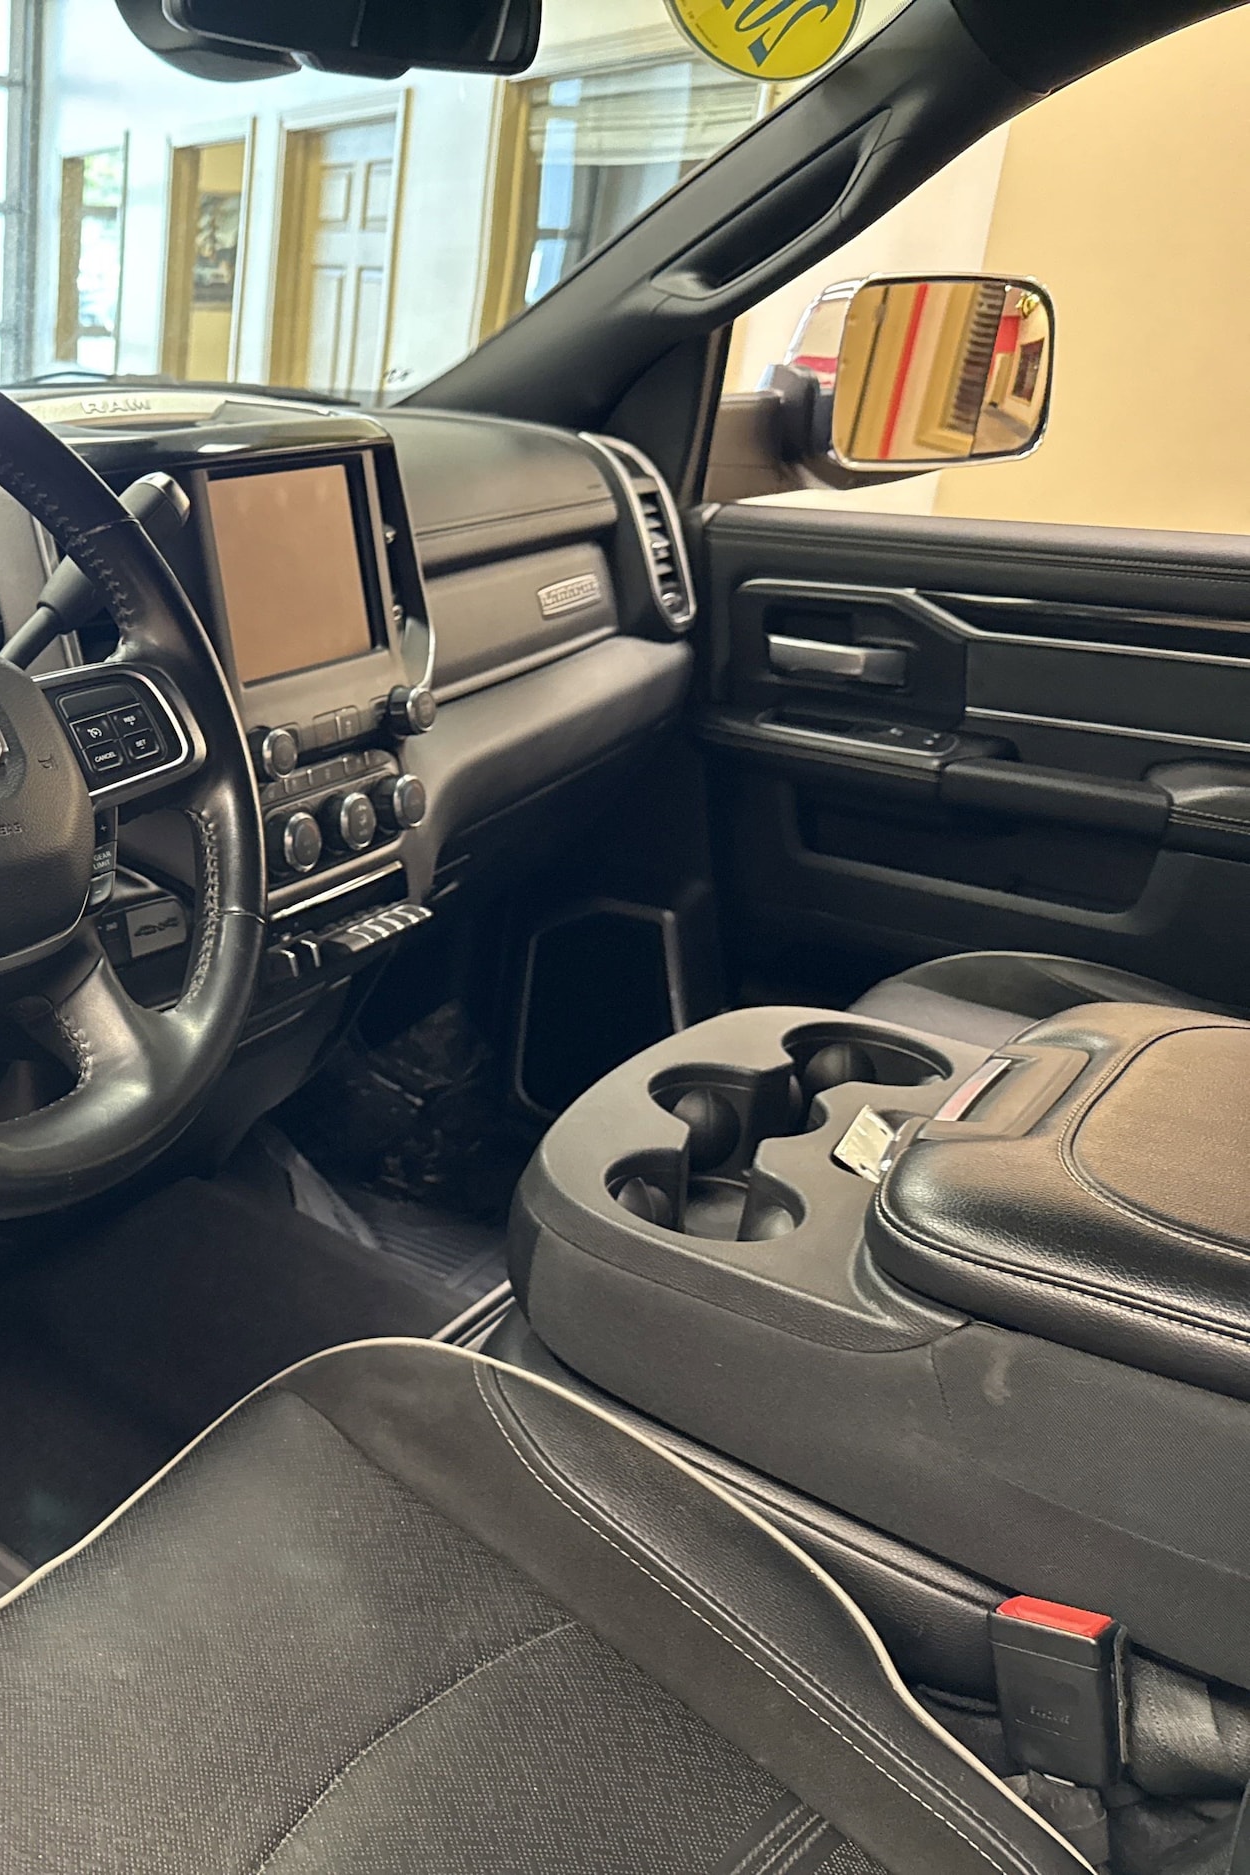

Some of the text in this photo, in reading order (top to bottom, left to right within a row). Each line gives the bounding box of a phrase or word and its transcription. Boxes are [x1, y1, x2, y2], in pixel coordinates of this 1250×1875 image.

[79, 398, 152, 415] RAM
[94, 751, 118, 763] CANCEL
[93, 850, 112, 862] GEAR
[92, 859, 111, 870] LIMIT
